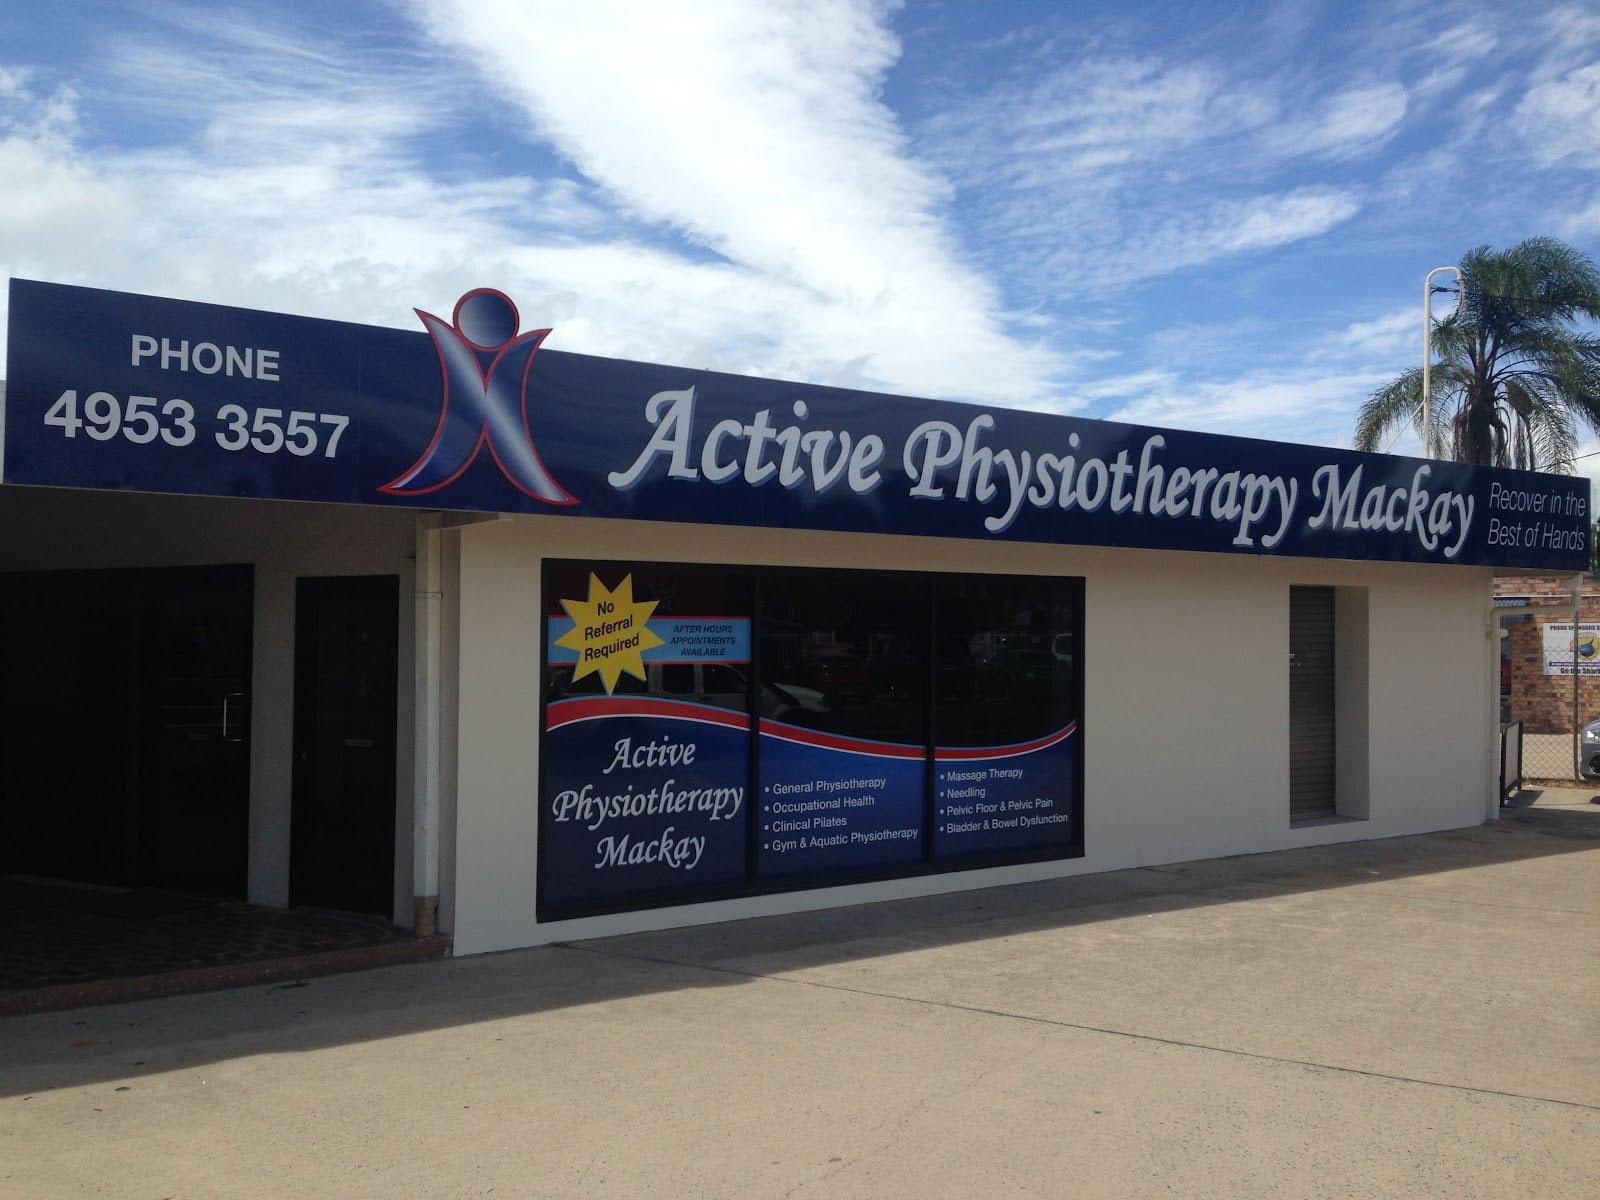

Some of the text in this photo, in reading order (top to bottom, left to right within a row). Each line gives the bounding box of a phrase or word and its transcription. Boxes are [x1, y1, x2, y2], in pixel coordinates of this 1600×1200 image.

[131, 334, 281, 382] PHONE
[43, 389, 350, 459] 4953 3557
[607, 384, 1475, 558] Active Physiotherapy Mackay
[1489, 482, 1586, 517] Recover in the
[1487, 518, 1585, 551] Best of Hands
[597, 600, 615, 617] No
[584, 614, 633, 641] Referral
[673, 625, 733, 634] AFTER HOURS
[584, 633, 640, 662] Required
[670, 636, 736, 645] APPOINTMENTS
[681, 648, 726, 657] AVAILABLE
[602, 735, 696, 774] Active
[772, 777, 886, 795] General Physiotherapy
[947, 768, 1023, 782] Massage Therapy
[552, 779, 744, 831] Physiotherapy
[772, 795, 875, 814] Occupational Health
[947, 788, 986, 799] Needling
[947, 798, 1053, 816] Pelvic Floor & Pelvic Pain
[772, 816, 847, 832] Clinical Pilates
[947, 813, 1068, 834] Bladder & Bowel Dysfunction
[594, 826, 706, 870] Mackay
[772, 828, 918, 853] Gym & Aquatic Physiotherapy
